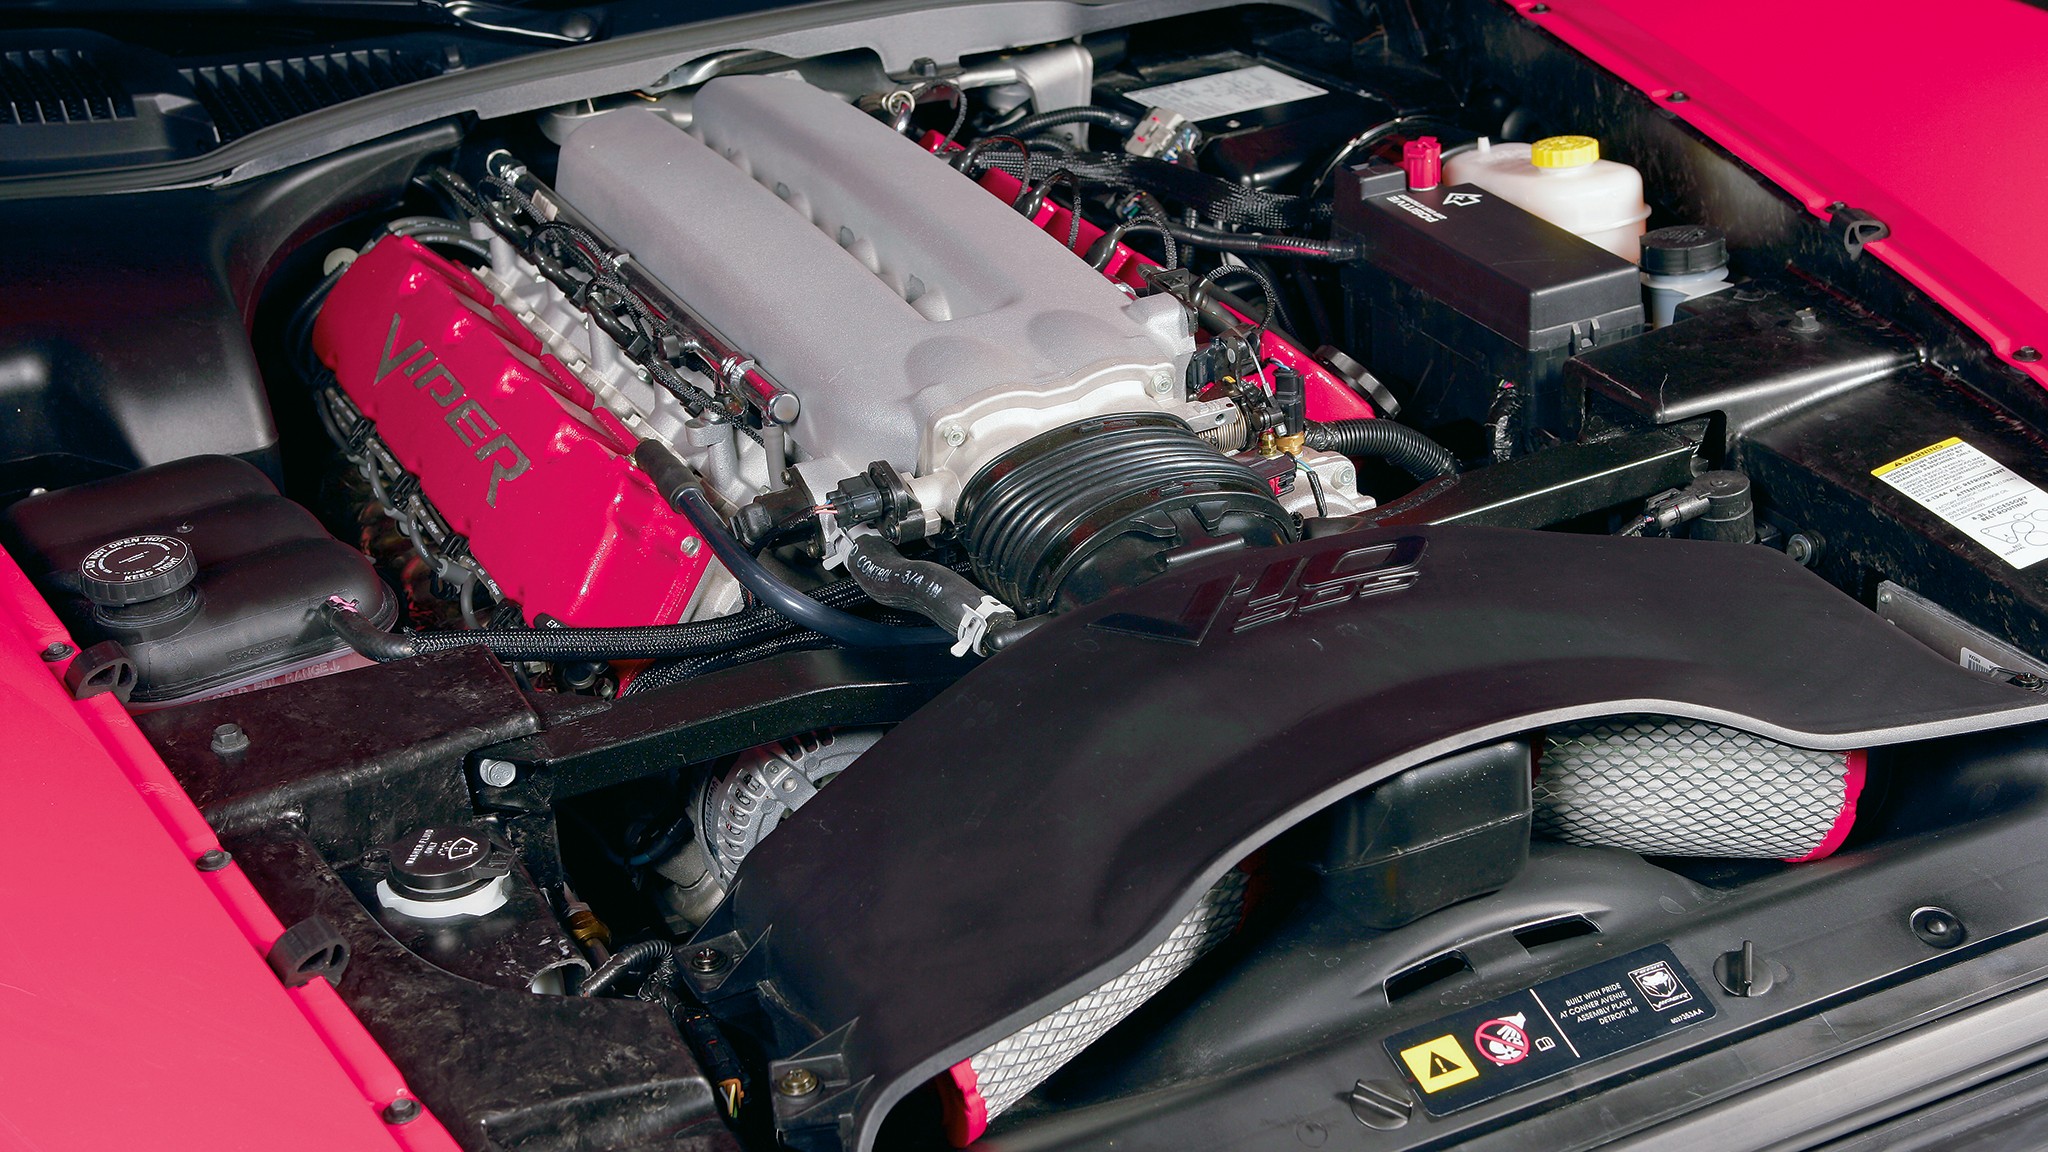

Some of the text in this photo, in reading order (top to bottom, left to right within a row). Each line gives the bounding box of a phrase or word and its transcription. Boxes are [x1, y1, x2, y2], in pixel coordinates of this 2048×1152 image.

[1387, 195, 1440, 223] POSITIVE
[373, 312, 531, 509] VIPER
[1904, 444, 1943, 463] WARNING
[1963, 467, 2005, 487] REFRIGERANT
[1956, 480, 1991, 496] ATTENTION
[1981, 513, 1997, 521] BELT
[1997, 500, 2028, 515] ROUTING
[1987, 495, 2027, 514] ACCESSORY
[89, 547, 108, 559] NOT
[109, 537, 140, 549] OPEN
[85, 560, 96, 569] DO
[124, 557, 181, 581] KEEP TIGHT
[857, 555, 892, 582] CONTROL
[901, 569, 924, 588] 3/4
[925, 581, 943, 598] IN
[283, 661, 328, 684] RANGE
[1560, 990, 1628, 1019] AT CONNER AVENUE
[1565, 982, 1622, 1007] BUILT WITH PRIDE
[1652, 992, 1689, 1009] VIPER
[1577, 998, 1634, 1023] ASSEMBLY PLANT
[1598, 1006, 1640, 1025] DETROIT, MI
